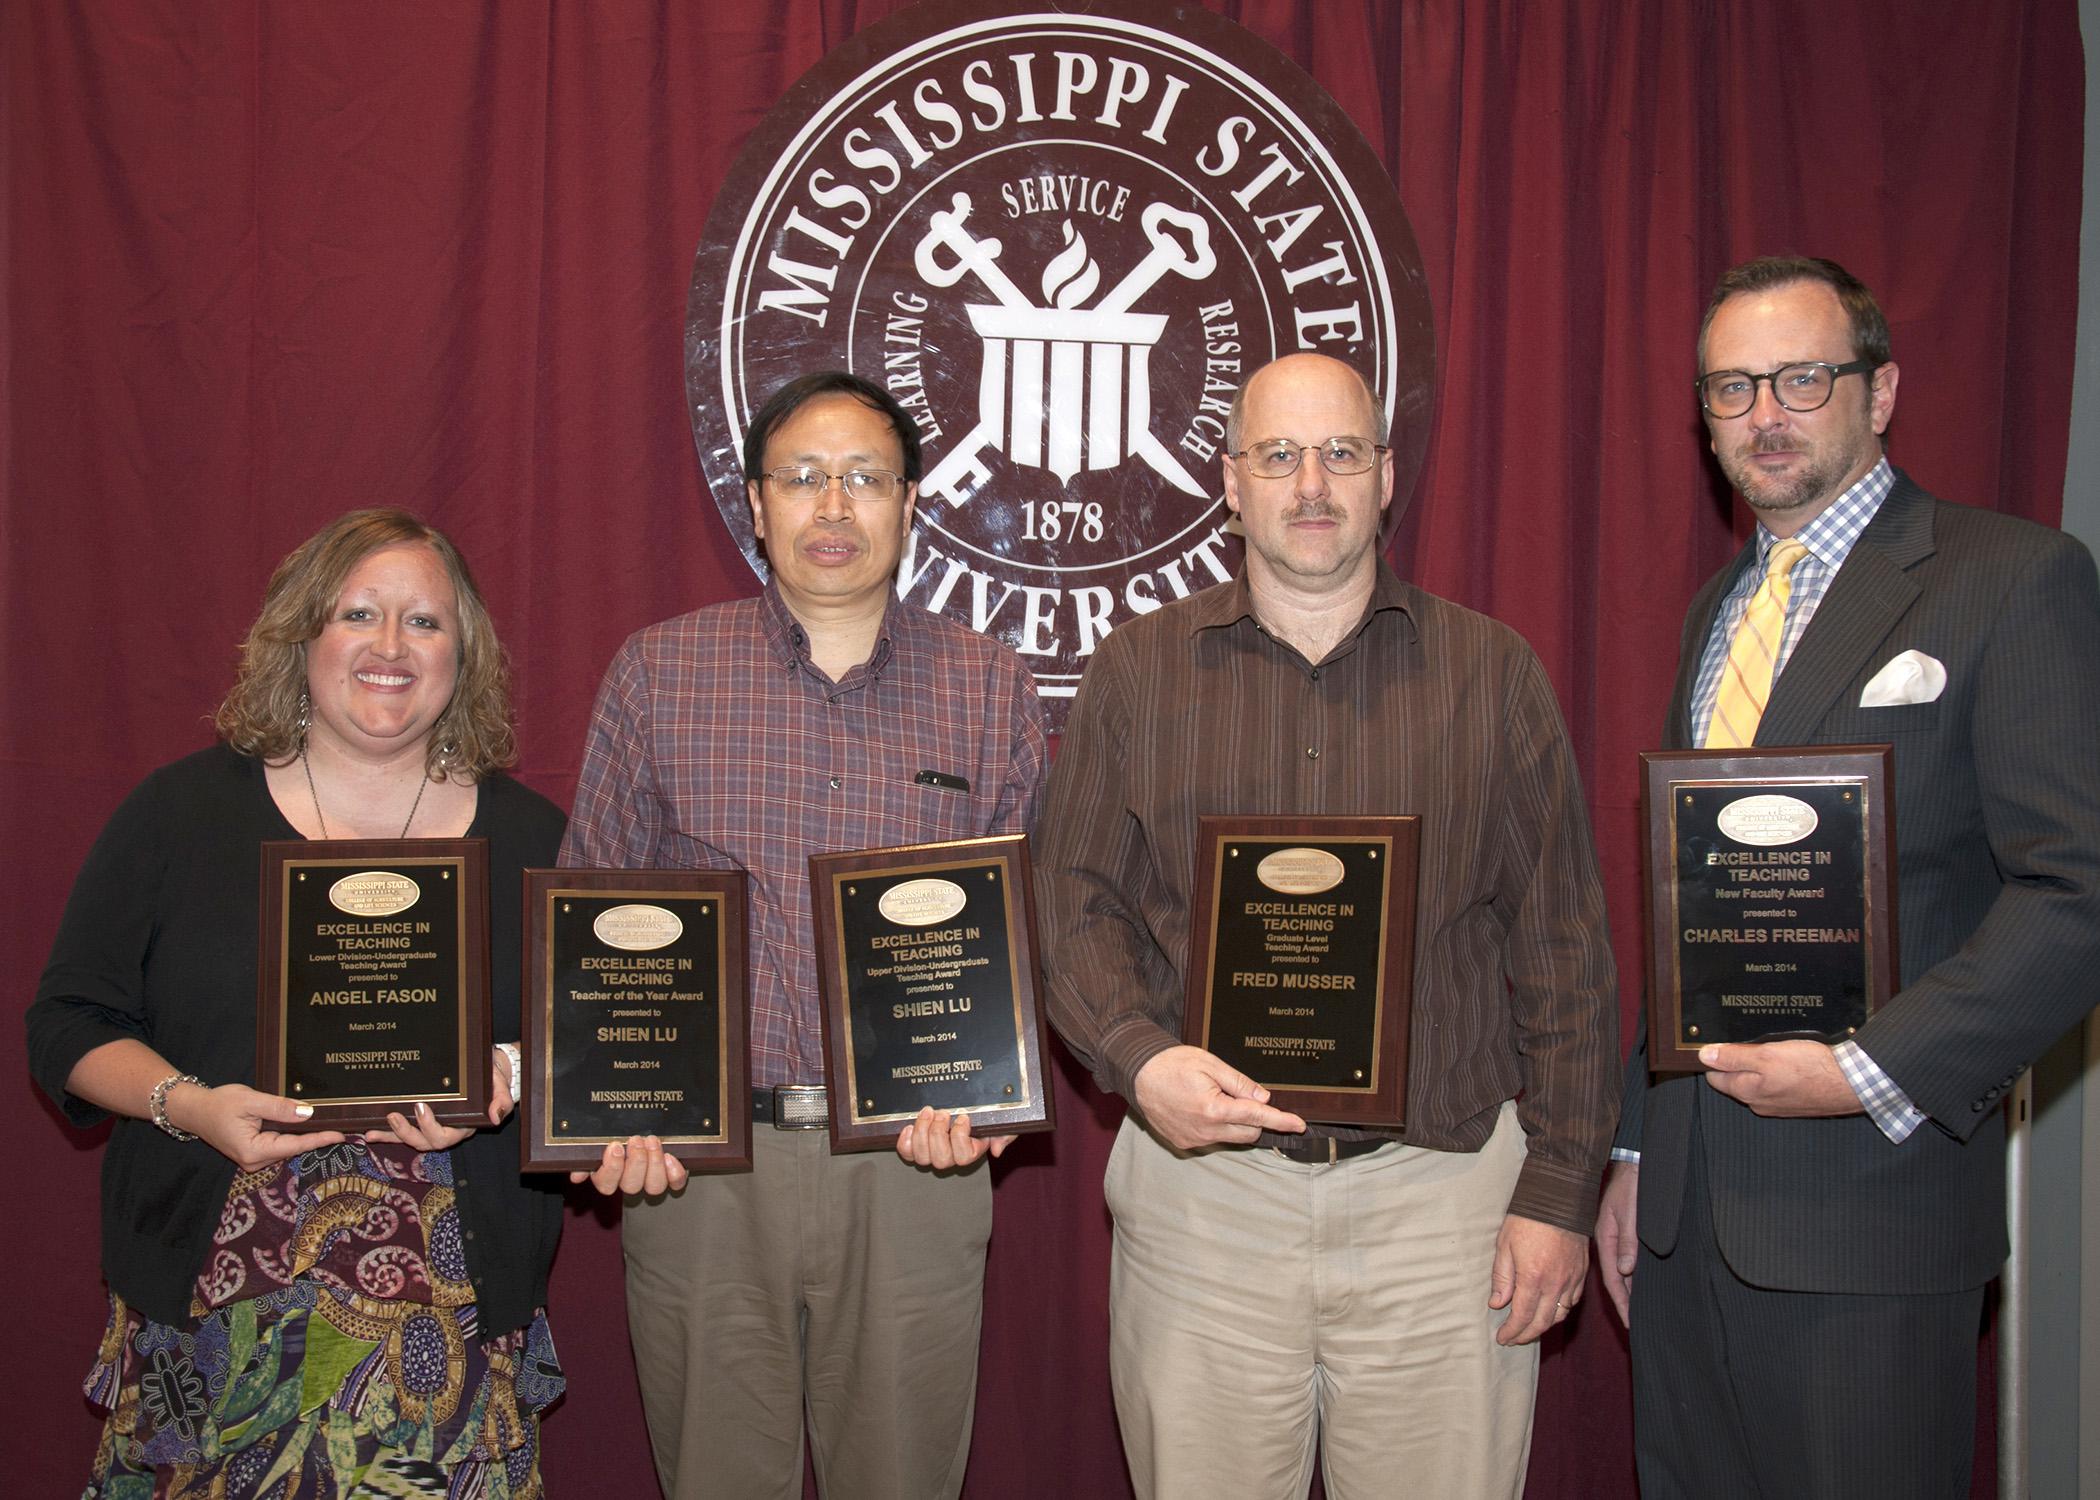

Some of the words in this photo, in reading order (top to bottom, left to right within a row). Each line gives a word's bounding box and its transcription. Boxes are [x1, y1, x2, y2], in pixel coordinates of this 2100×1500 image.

[757, 51, 1190, 328] MISSISSIPPI
[1196, 115, 1364, 350] STATE
[1001, 174, 1131, 222] SERVICE
[883, 290, 943, 445] LEARNING
[1179, 297, 1242, 464] RESEARCH
[1021, 501, 1104, 544] 1878
[896, 513, 1246, 656] NIVERSIT
[1707, 853, 1810, 865] EXCELLENCE
[1815, 852, 1831, 864] IN
[1729, 869, 1810, 882] TEACHING
[341, 882, 385, 890] MISSISSIPPI
[1716, 889, 1740, 898] New
[1743, 889, 1785, 900] Faculty
[1788, 889, 1824, 898] Award
[1245, 903, 1336, 915] EXCELLENCE
[1340, 904, 1353, 916] IN
[1743, 909, 1787, 918] presented
[1788, 909, 1797, 917] to
[317, 924, 412, 936] EXCELLENCE
[416, 923, 430, 933] IN
[1263, 919, 1333, 931] TEACHING
[872, 930, 963, 949] EXCELLENCE
[966, 927, 980, 938] IN
[1267, 934, 1304, 943] Graduate
[1306, 934, 1328, 943] Level
[1684, 929, 1768, 943] CHARLES
[1773, 928, 1859, 943] FREEMAN
[337, 937, 411, 949] TEACHING
[1265, 944, 1301, 953] Teaching
[1303, 944, 1329, 952] Award
[309, 953, 336, 962] Lower
[338, 951, 437, 962] Division-Undergraduate
[891, 945, 963, 962] TEACHING
[1272, 955, 1309, 964] presented
[1311, 955, 1319, 963] to
[340, 962, 378, 971] Teaching
[380, 961, 406, 969] Award
[581, 958, 675, 970] EXCELLENCE
[678, 959, 692, 970] IN
[867, 967, 892, 977] Upper
[894, 958, 989, 974] Division-Undergraduate
[1746, 964, 1773, 972] March
[1775, 964, 1797, 972] 2014
[348, 974, 388, 983] presented
[601, 973, 673, 985] TEACHING
[896, 972, 933, 983] Teaching
[935, 969, 960, 978] Award
[1233, 973, 1278, 987] FRED
[1283, 975, 1355, 989] MUSSER
[906, 984, 944, 994] presented
[946, 982, 953, 990] to
[310, 991, 372, 1006] ANGEL
[377, 989, 436, 1003] FASON
[570, 991, 611, 1000] Teacher
[613, 991, 625, 1000] of
[627, 991, 644, 1000] the
[646, 991, 669, 1000] Year
[671, 991, 703, 1000] Award
[1722, 996, 1788, 1007] MISSISSIPPI
[1790, 996, 1823, 1006] STATE
[612, 1009, 652, 1018] presented
[653, 1009, 661, 1017] to
[893, 1001, 945, 1018] SHIEN
[949, 998, 971, 1013] LU
[1269, 1007, 1293, 1016] March
[1295, 1008, 1314, 1016] 2014
[597, 1027, 650, 1042] SHIEN
[655, 1028, 677, 1042] LU
[912, 1035, 935, 1043] March
[937, 1032, 957, 1041] 2014
[1245, 1036, 1304, 1049] MISSISSIPPI
[1306, 1039, 1335, 1050] STATE
[326, 1052, 388, 1063] MISSISSIPPI
[390, 1050, 420, 1061] STATE
[614, 1061, 638, 1069] March
[641, 1061, 660, 1069] 2014
[892, 1063, 952, 1078] MISSISSIPPI
[953, 1060, 982, 1072] STATE
[911, 1074, 965, 1083] UNIVERSITY
[591, 1091, 652, 1101] MISSISSIPPI
[654, 1091, 683, 1101] STATE
